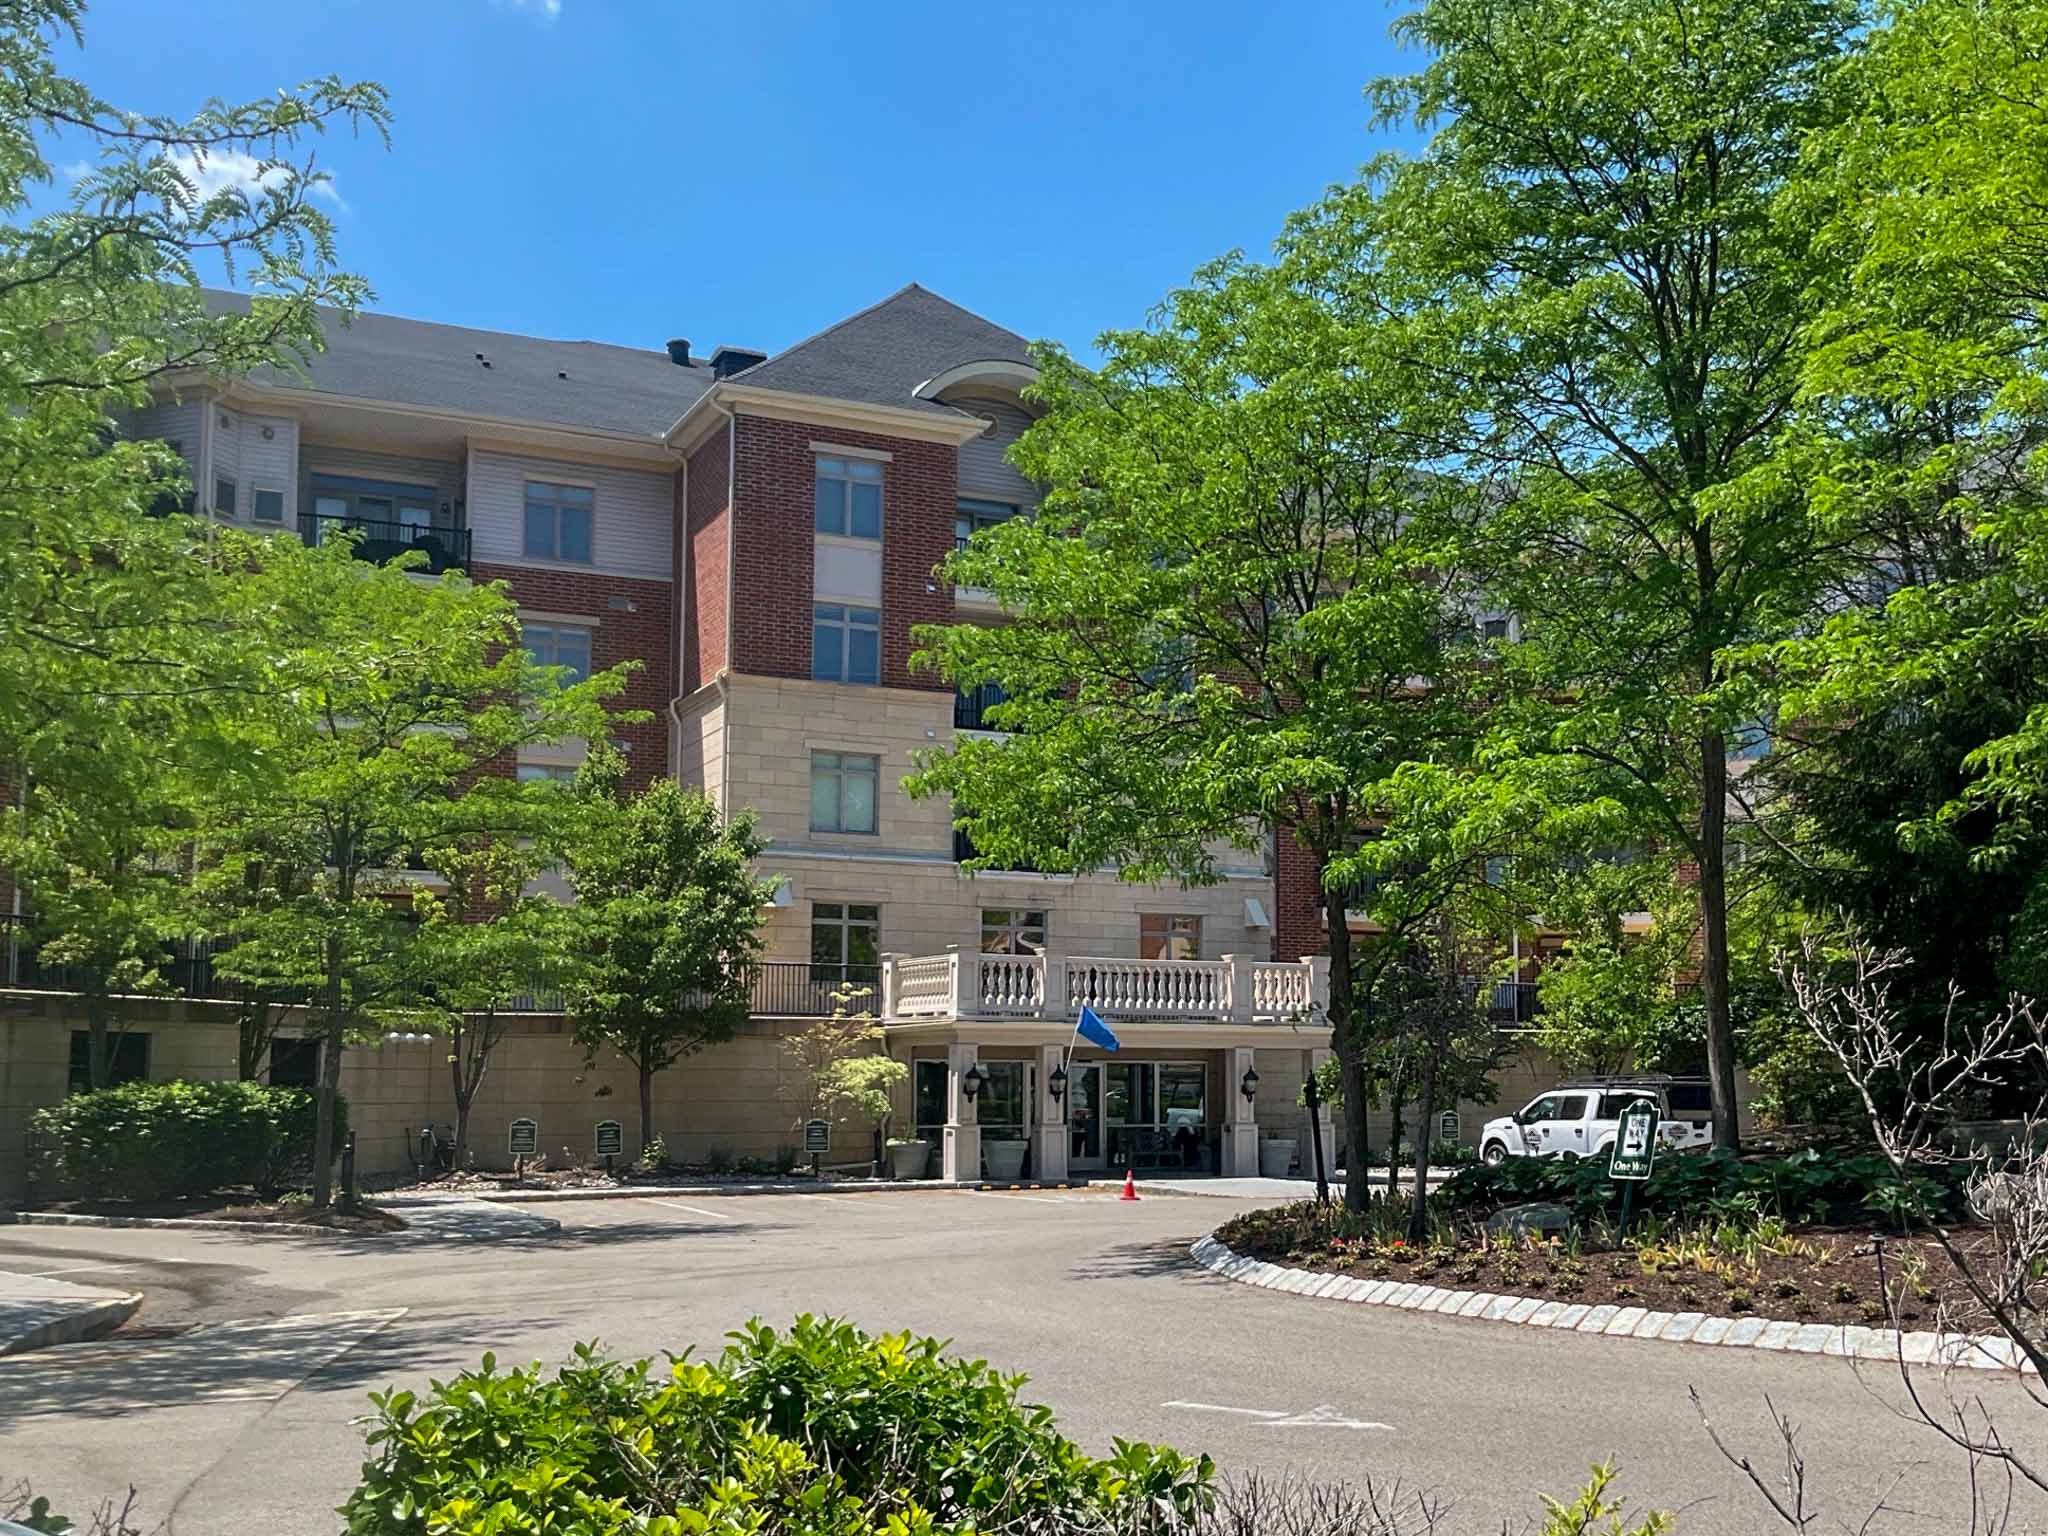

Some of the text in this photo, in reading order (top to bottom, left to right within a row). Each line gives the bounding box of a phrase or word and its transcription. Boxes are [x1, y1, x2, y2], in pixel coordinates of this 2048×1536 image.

[1631, 1119, 1646, 1127] ONE
[1629, 1129, 1645, 1137] WAY
[1614, 1160, 1648, 1174] One Way
